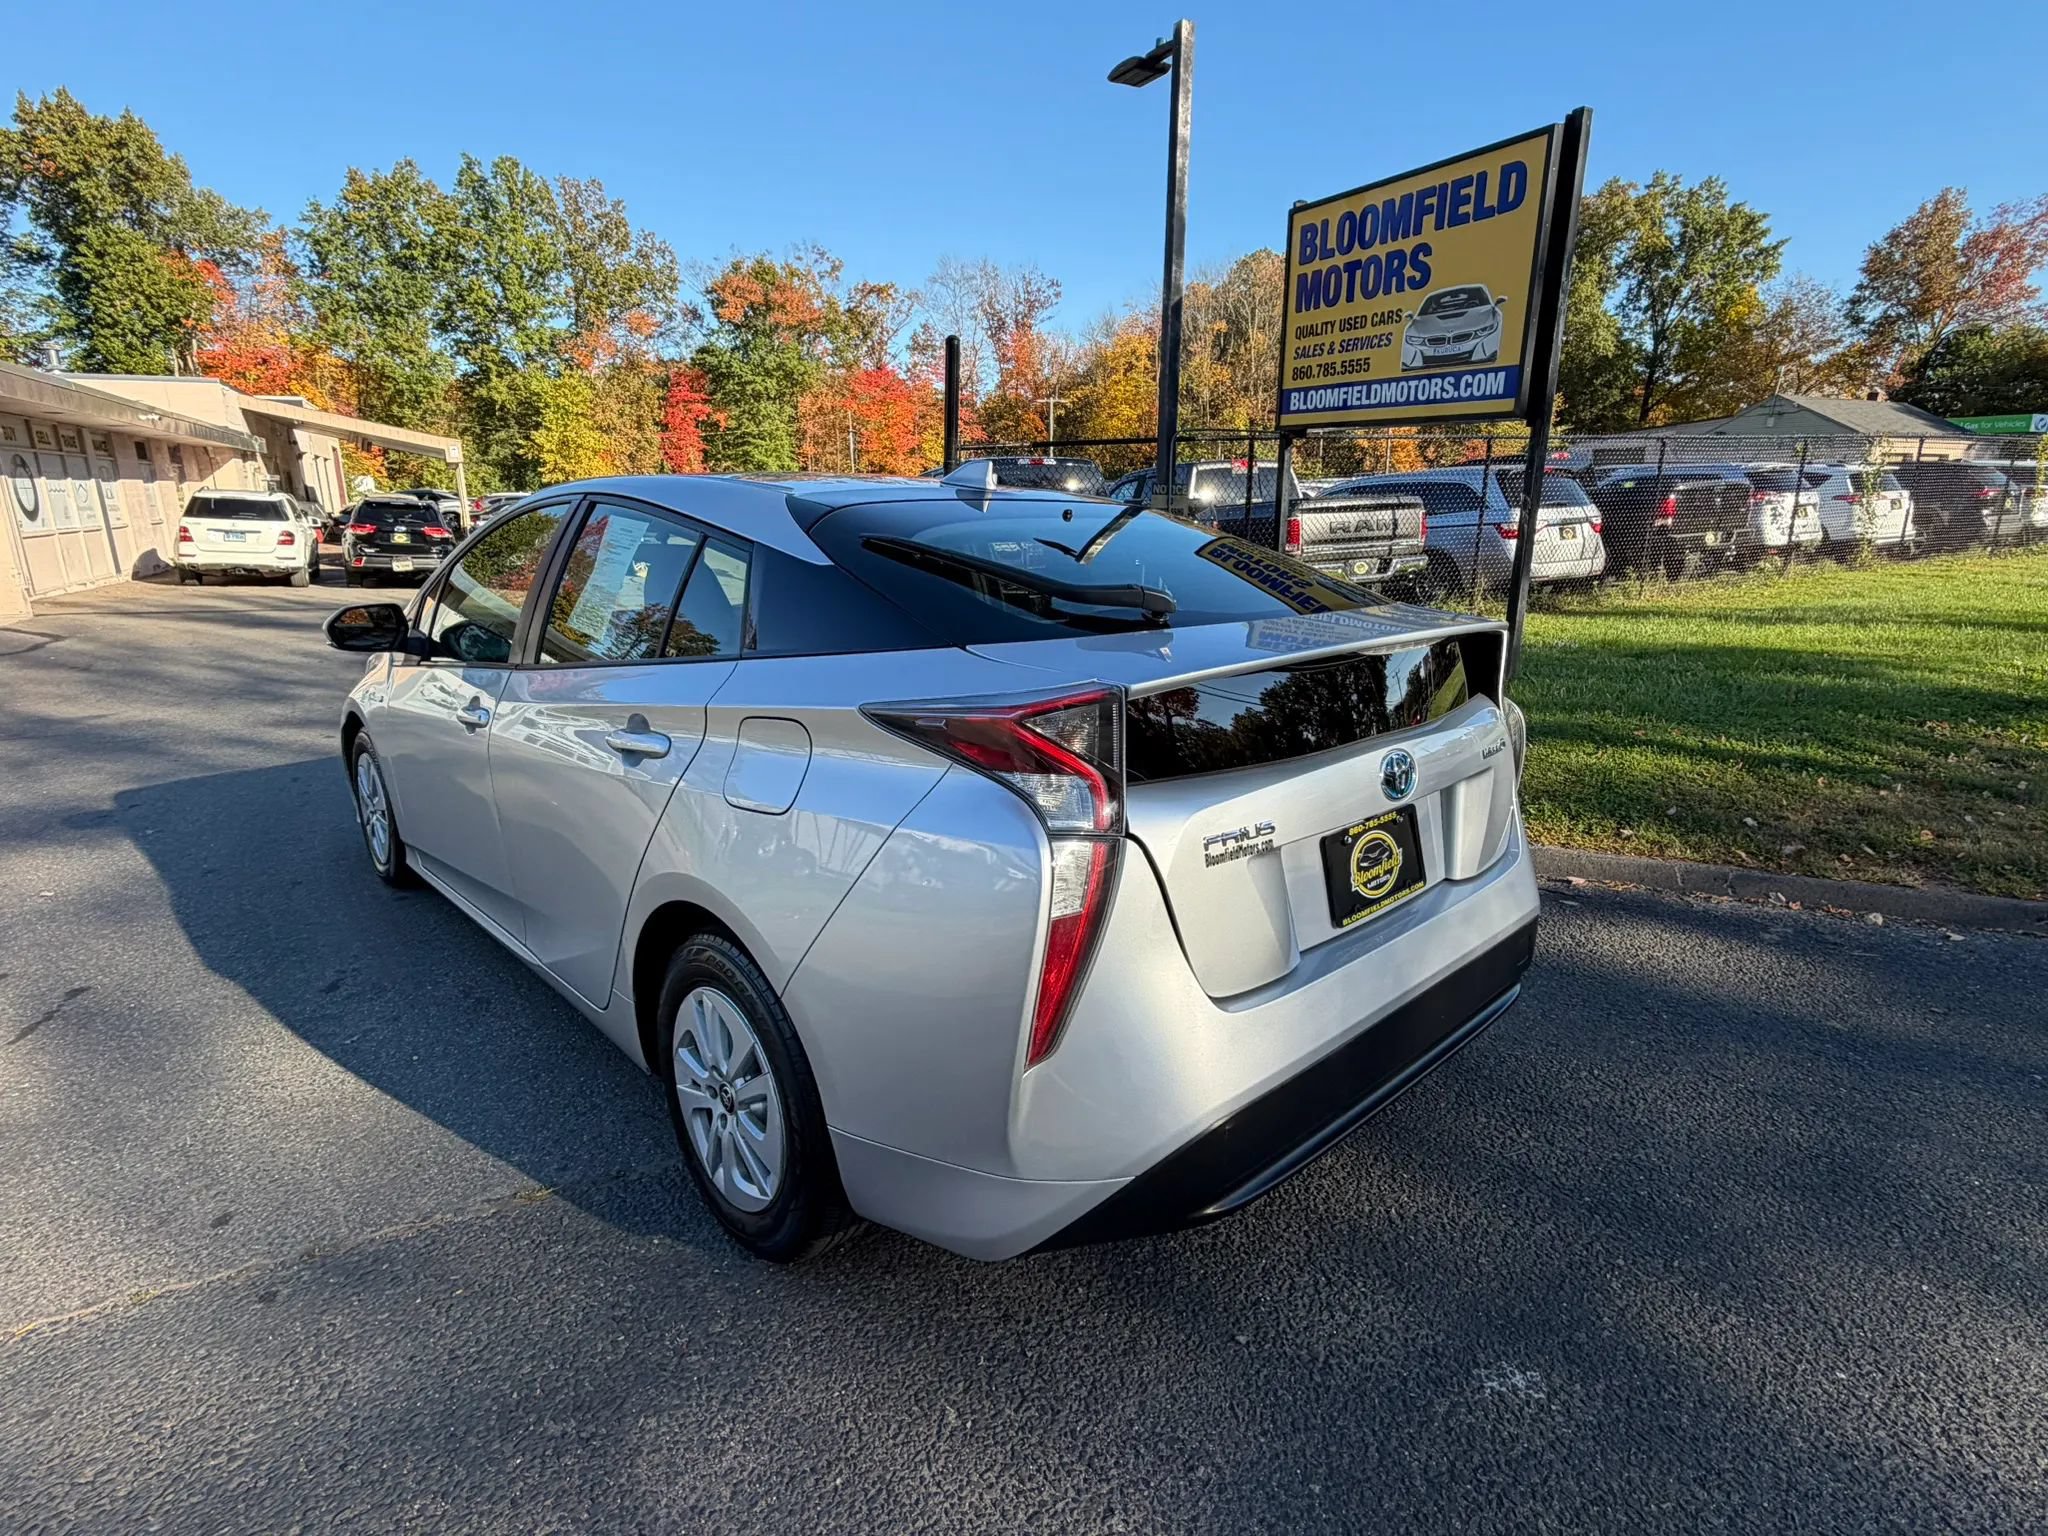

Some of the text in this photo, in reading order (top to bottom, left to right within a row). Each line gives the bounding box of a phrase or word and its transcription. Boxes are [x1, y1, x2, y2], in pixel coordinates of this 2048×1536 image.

[1298, 160, 1528, 266] BLOOMFIELD
[1295, 242, 1433, 314] MOTORS
[1295, 307, 1404, 341] QUALITY USED CARS
[1293, 331, 1394, 361] SALES & SERVICES
[1291, 357, 1371, 382] 860.785.5555
[1289, 371, 1506, 411] BLOOMFIELDMOTORS.COM
[1152, 484, 1188, 495] NOICE
[1329, 519, 1393, 535] RAM
[1354, 854, 1401, 886] Bloomfield
[1342, 881, 1425, 926] BLOOMFIELDMOTORS.COM
